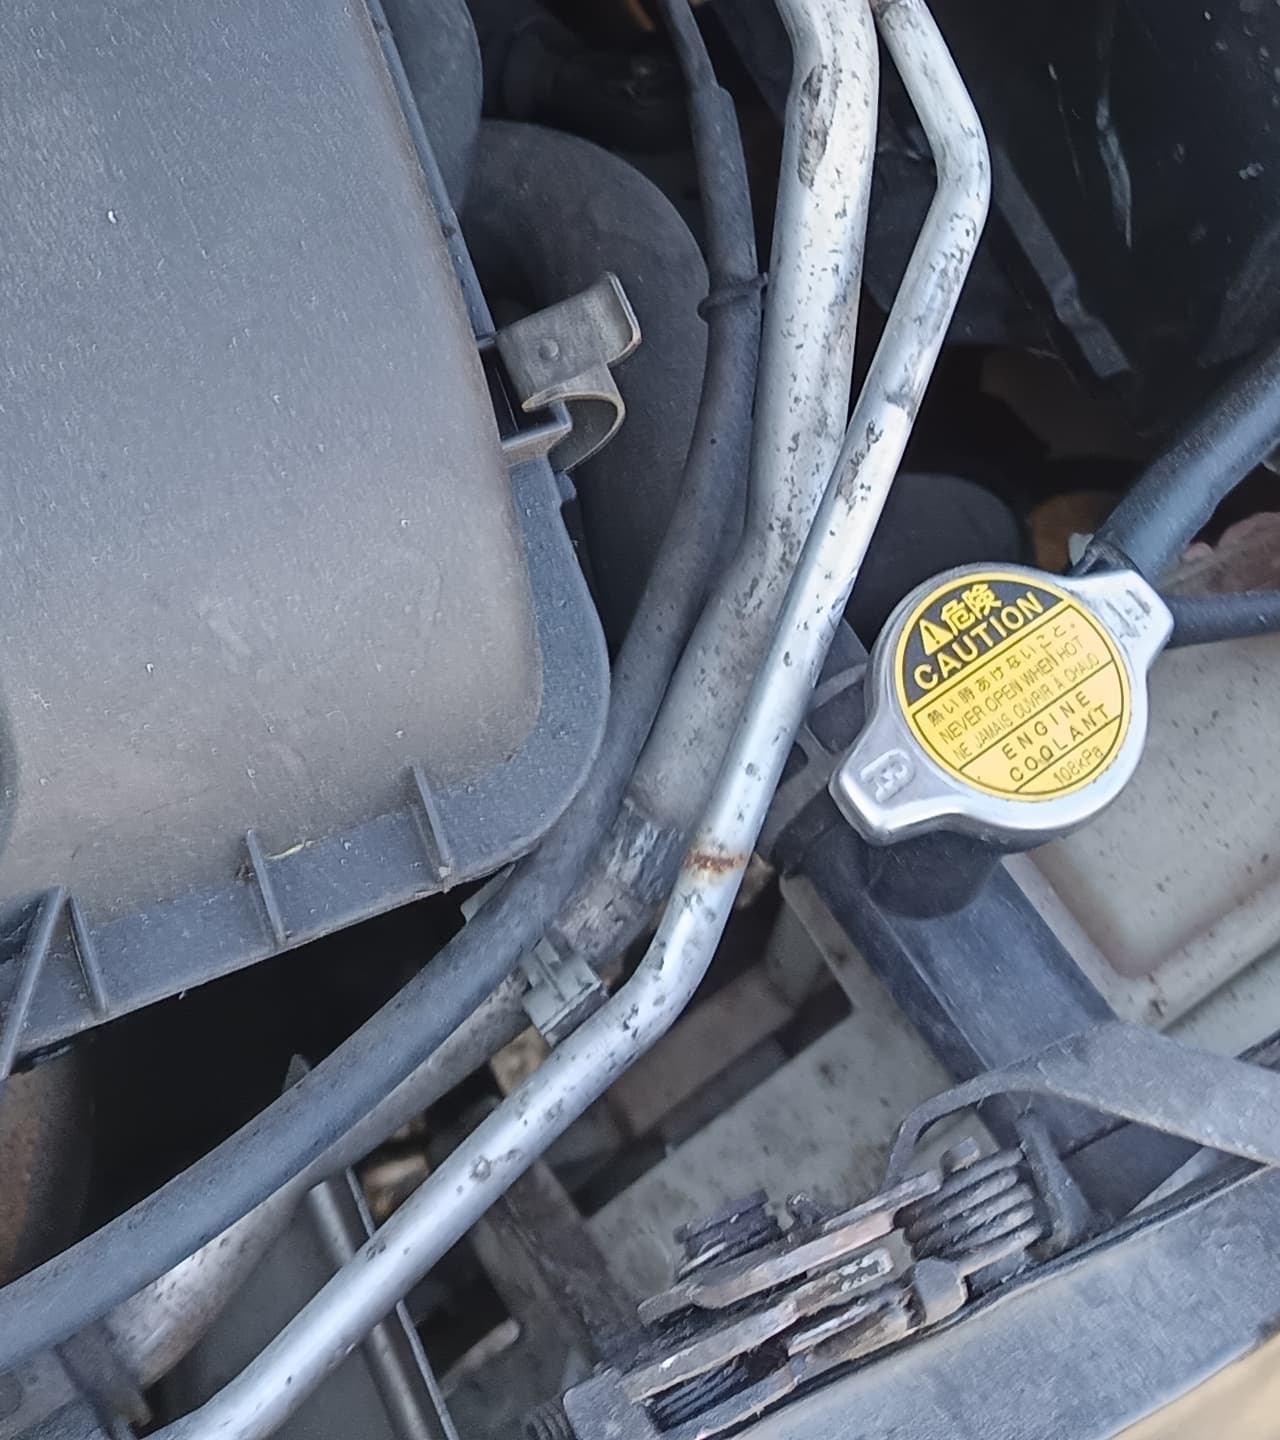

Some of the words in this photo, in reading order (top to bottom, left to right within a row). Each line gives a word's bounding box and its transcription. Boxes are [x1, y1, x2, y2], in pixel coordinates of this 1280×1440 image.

[913, 591, 1045, 690] CAUTION
[940, 583, 1003, 635] 危険
[939, 708, 986, 743] NEVER
[985, 677, 1023, 714] OPEN
[1023, 652, 1058, 692] WHEN
[1057, 636, 1084, 661] HOT
[953, 744, 973, 763] NE
[975, 711, 1014, 748] JAMAIS
[1063, 653, 1100, 682] CHAUD
[1002, 690, 1092, 761] ENGINE
[1009, 702, 1111, 784] COOLANT
[1052, 743, 1106, 786] 108kPa
